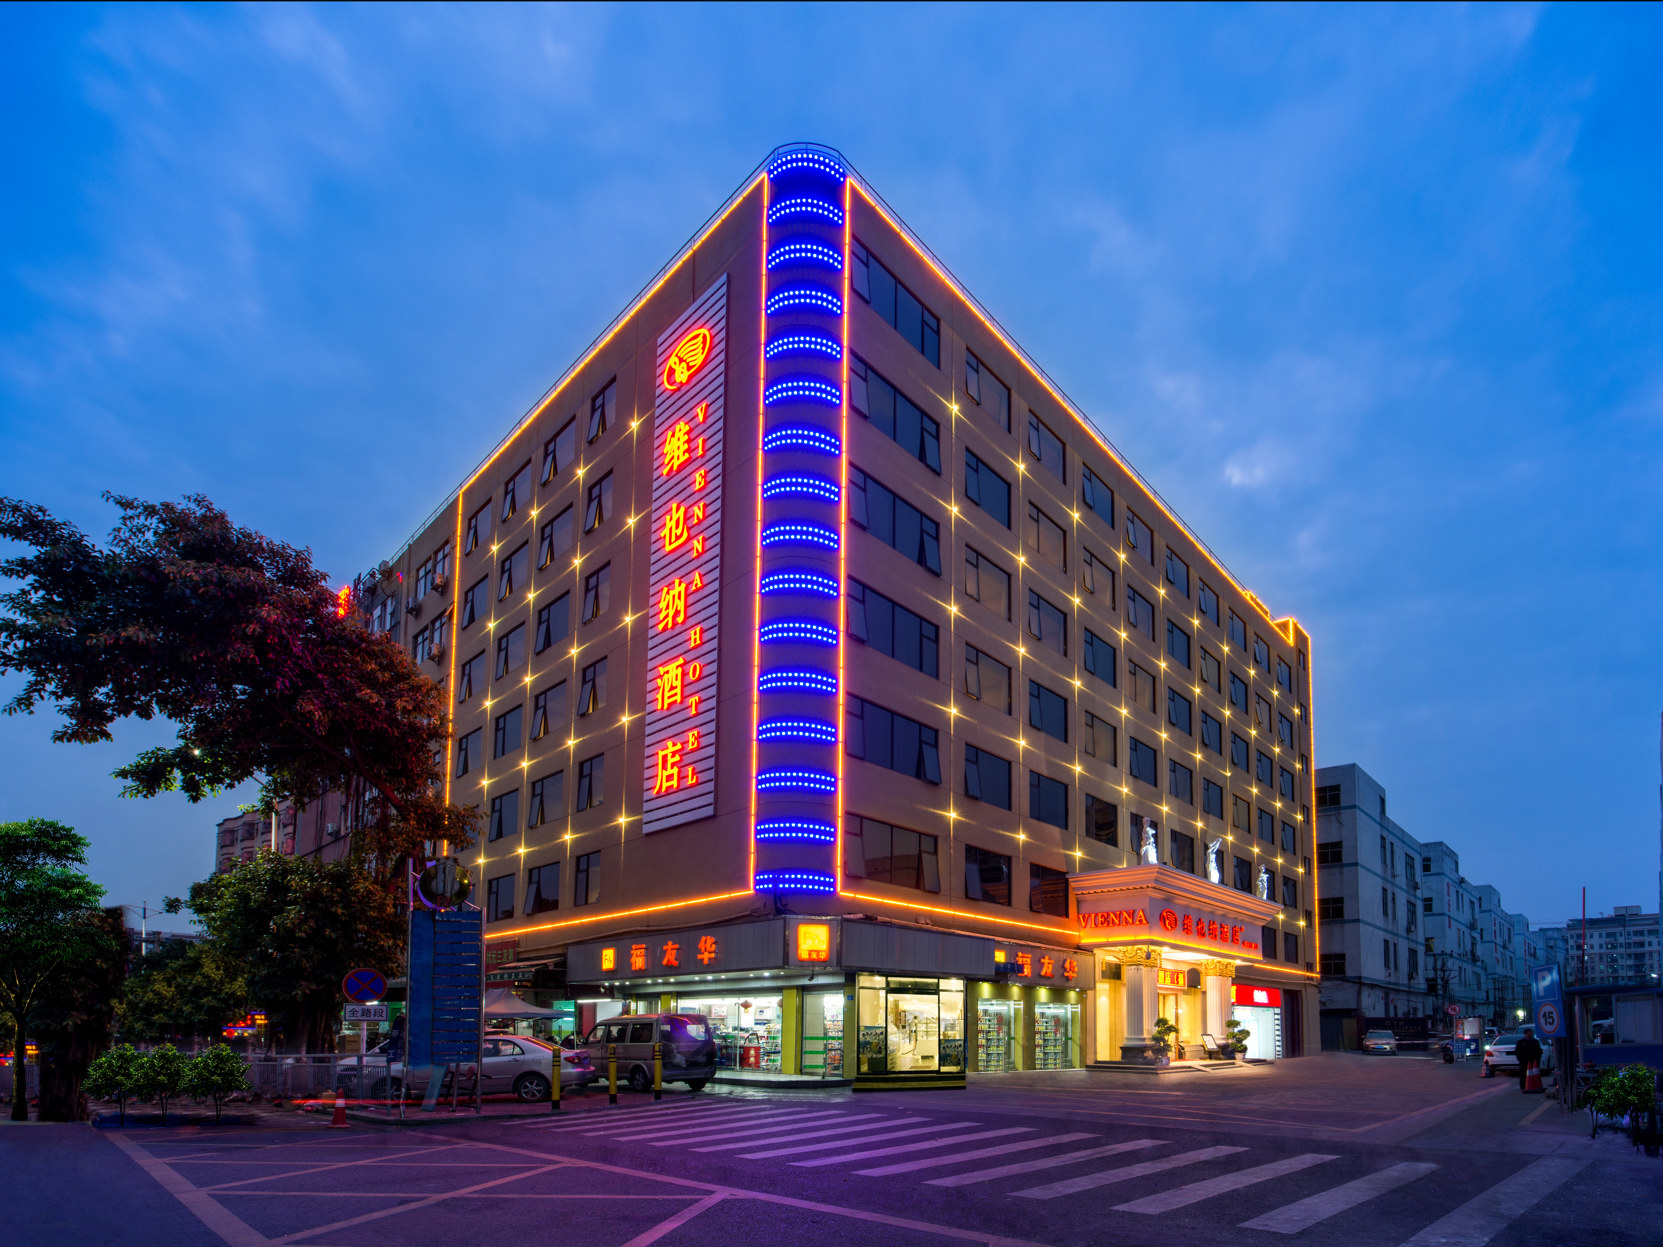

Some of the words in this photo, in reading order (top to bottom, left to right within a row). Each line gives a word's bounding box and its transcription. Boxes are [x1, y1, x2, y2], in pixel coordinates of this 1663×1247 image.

[690, 402, 708, 592] VIENNA
[652, 421, 691, 795] 维也纳酒店
[687, 626, 703, 786] HOTEL
[1078, 908, 1149, 929] VIENNA
[1182, 914, 1241, 946] 维也纳酒店
[630, 935, 717, 971] 福友华
[801, 950, 827, 960] 福友华
[1015, 951, 1079, 981] 福友华
[1536, 970, 1551, 997] P
[348, 1007, 385, 1019] 全路段
[1541, 1010, 1555, 1026] 15
